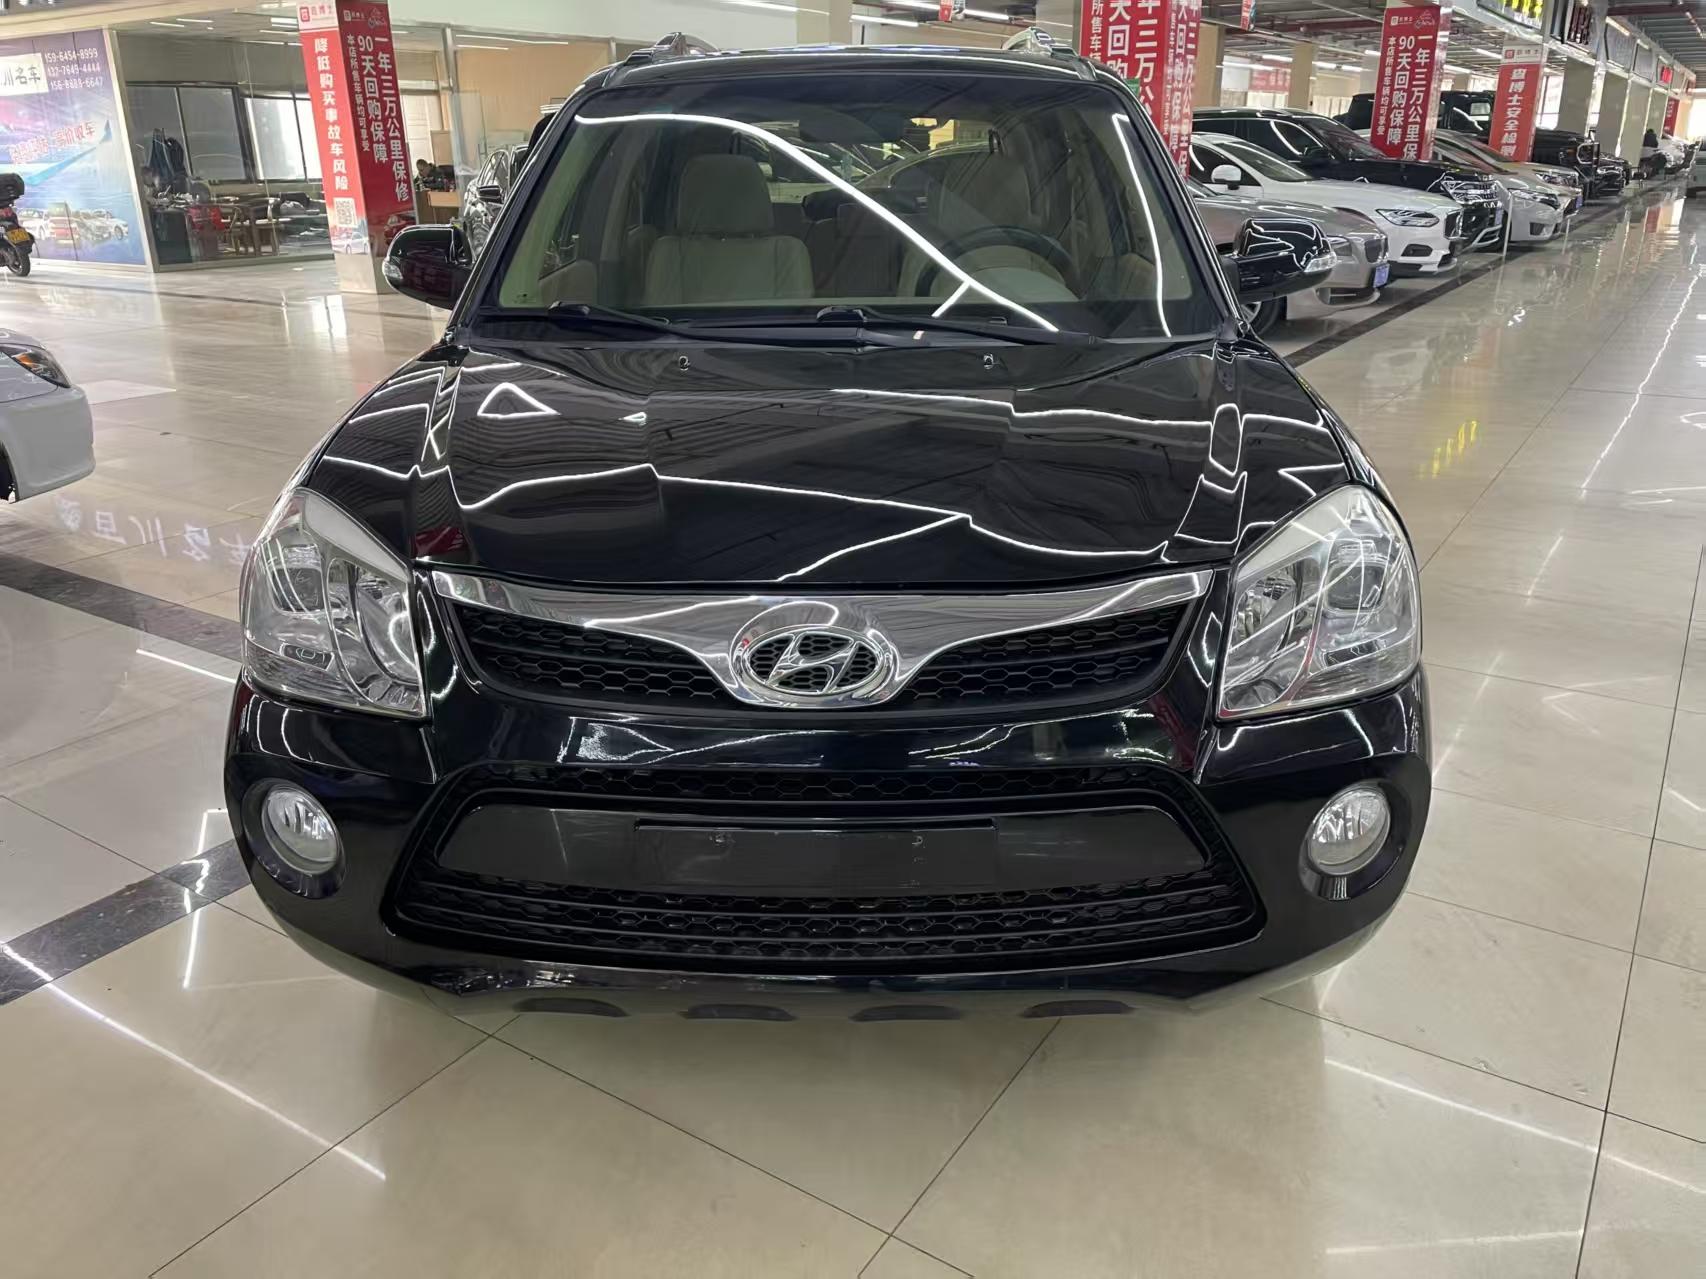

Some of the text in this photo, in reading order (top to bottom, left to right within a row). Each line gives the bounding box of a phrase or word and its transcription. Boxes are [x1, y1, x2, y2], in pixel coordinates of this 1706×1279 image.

[314, 37, 349, 190] 降低购买事故车风险
[357, 35, 388, 163] 90天回购保障
[375, 36, 410, 202] 一年三万公里保修
[1386, 35, 1415, 145] 90天回购保障
[1402, 35, 1433, 160] 一年三万公里保
